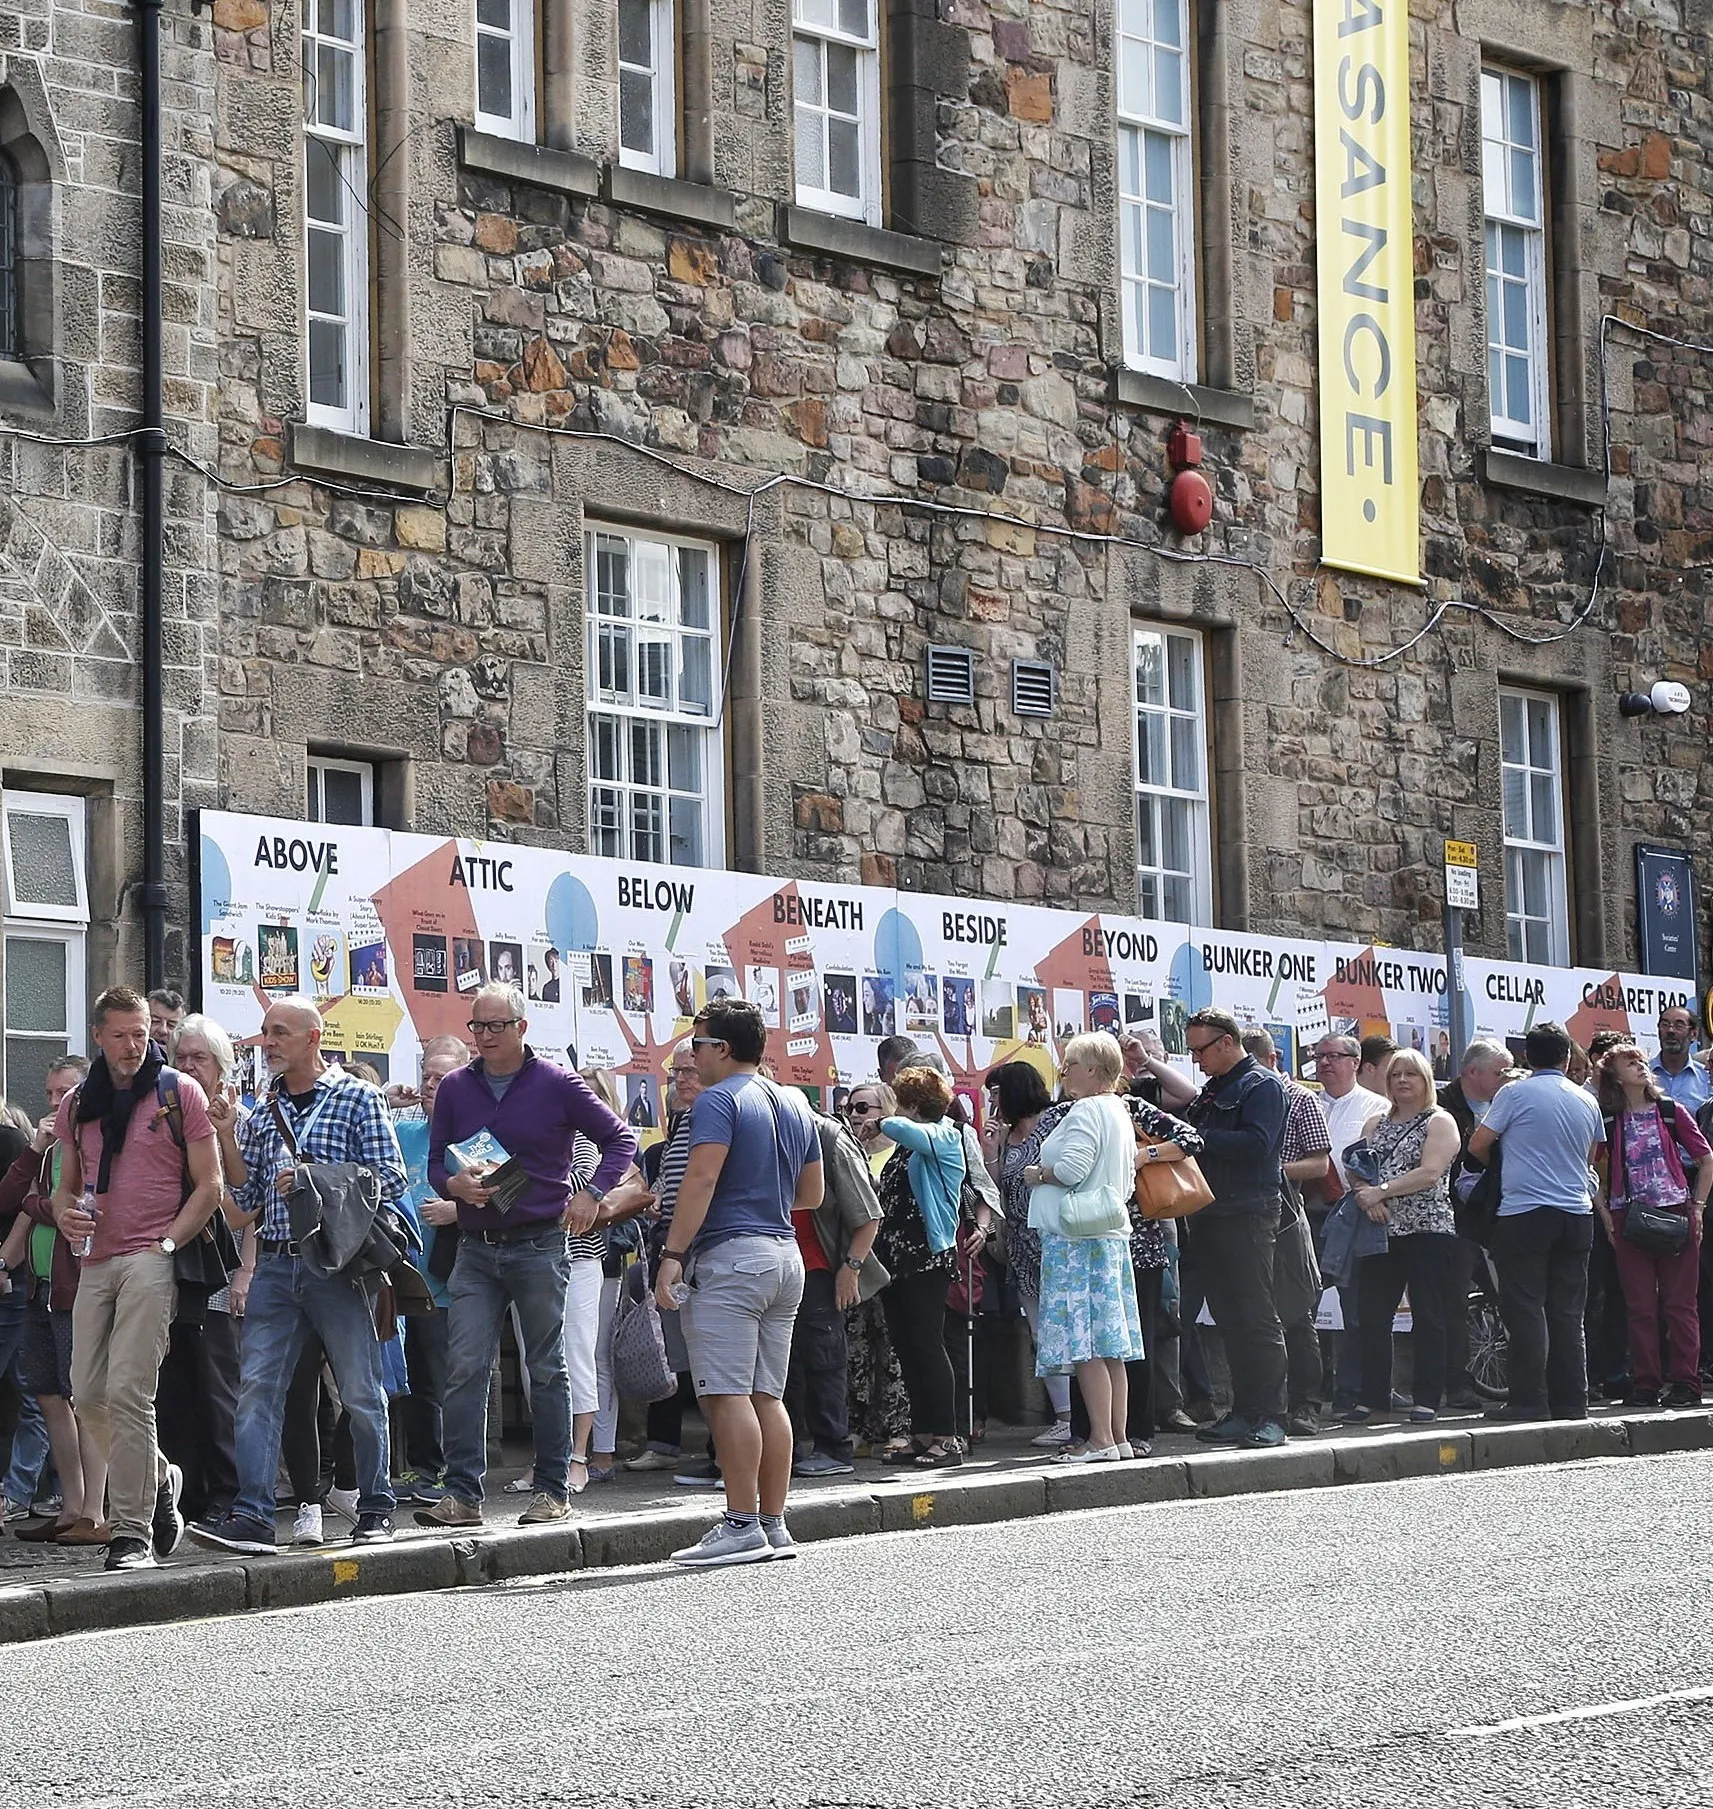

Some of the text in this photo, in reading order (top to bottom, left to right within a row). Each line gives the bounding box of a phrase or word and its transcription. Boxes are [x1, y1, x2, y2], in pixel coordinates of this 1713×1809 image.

[254, 835, 338, 875] ABOVE
[450, 856, 513, 892] ATTIC
[618, 876, 694, 914] BELOW
[773, 893, 864, 930] BENEATH
[942, 912, 1008, 946] BESIDE
[1083, 927, 1158, 963] BEYOND
[1203, 944, 1316, 983] BUNKER ONE
[1336, 957, 1402, 992] BUNKER
[1408, 966, 1447, 996] TWO
[1486, 974, 1546, 1006] CELLAR
[1583, 982, 1653, 1015] CABARET
[468, 1140, 486, 1151] THE
[470, 1144, 494, 1158] GIRLS
